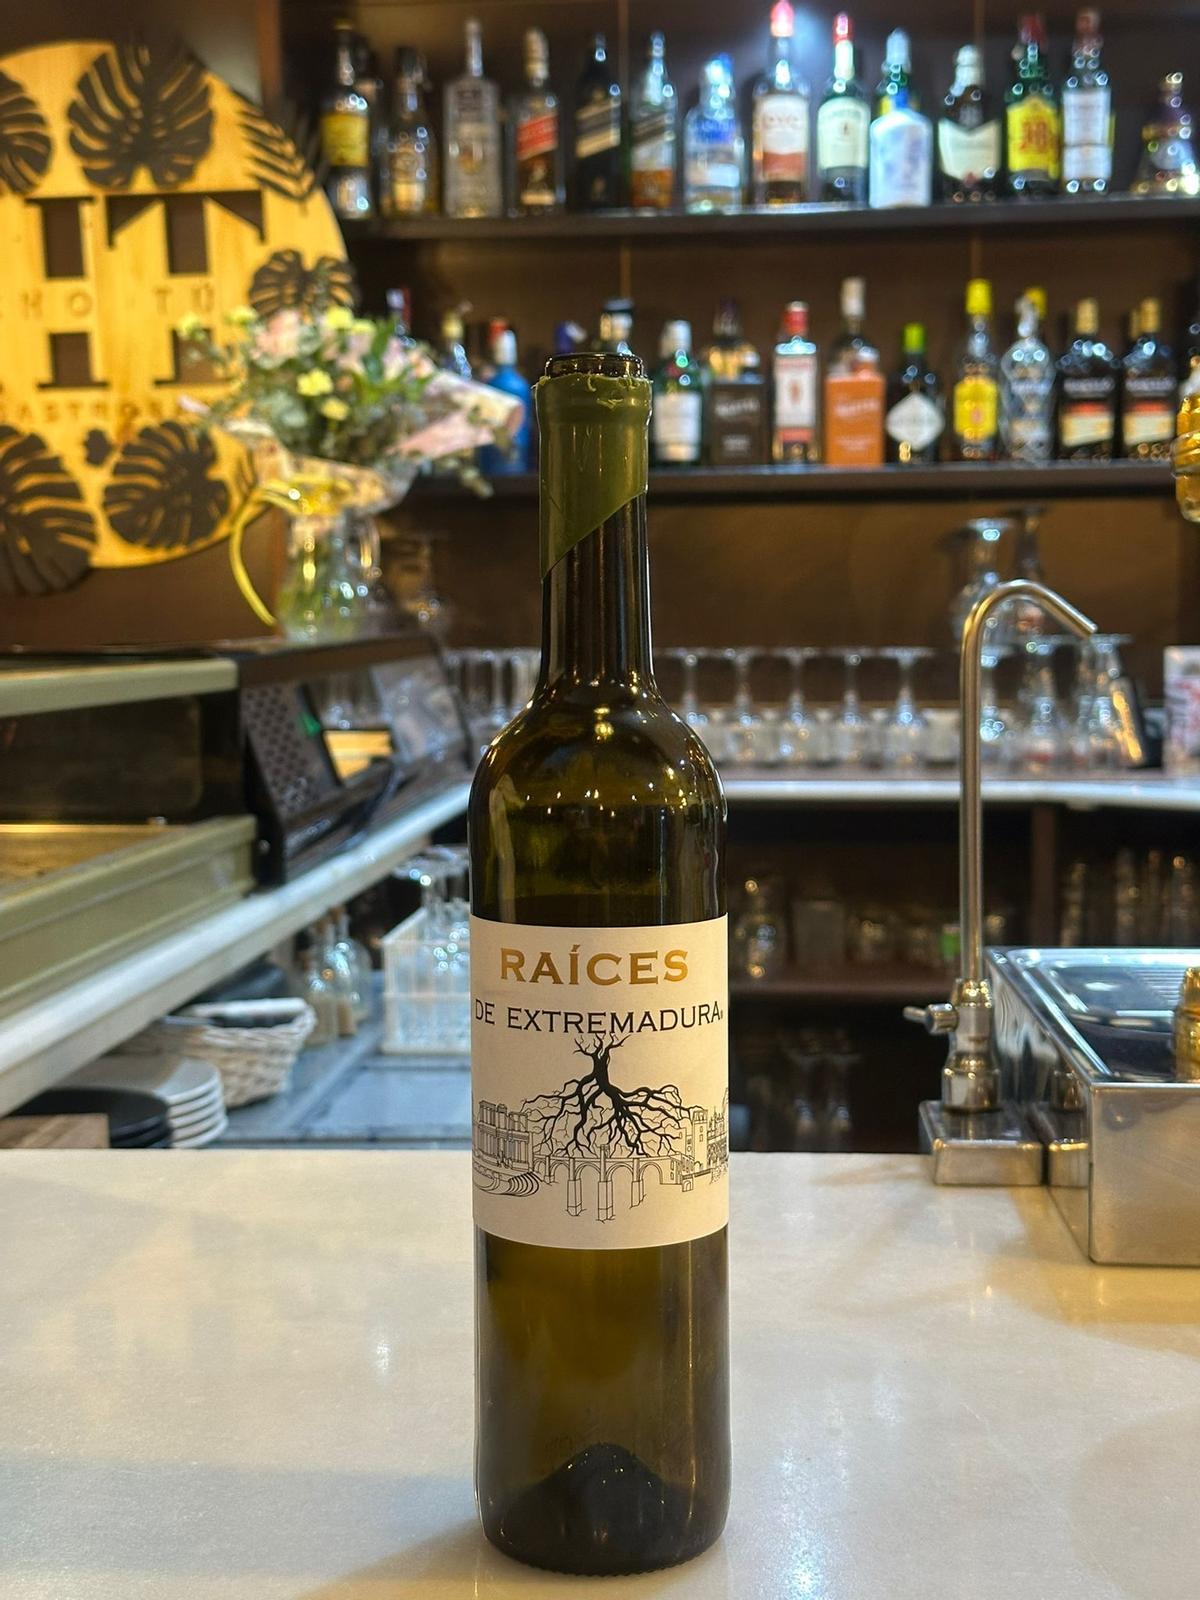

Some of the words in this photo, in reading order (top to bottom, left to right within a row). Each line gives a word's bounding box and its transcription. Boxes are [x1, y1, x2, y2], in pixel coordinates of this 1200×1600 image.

[0, 287, 93, 321] HO
[500, 944, 689, 986] RAÍCES
[475, 998, 495, 1026] DE
[507, 1000, 721, 1034] EXTREMADURA
